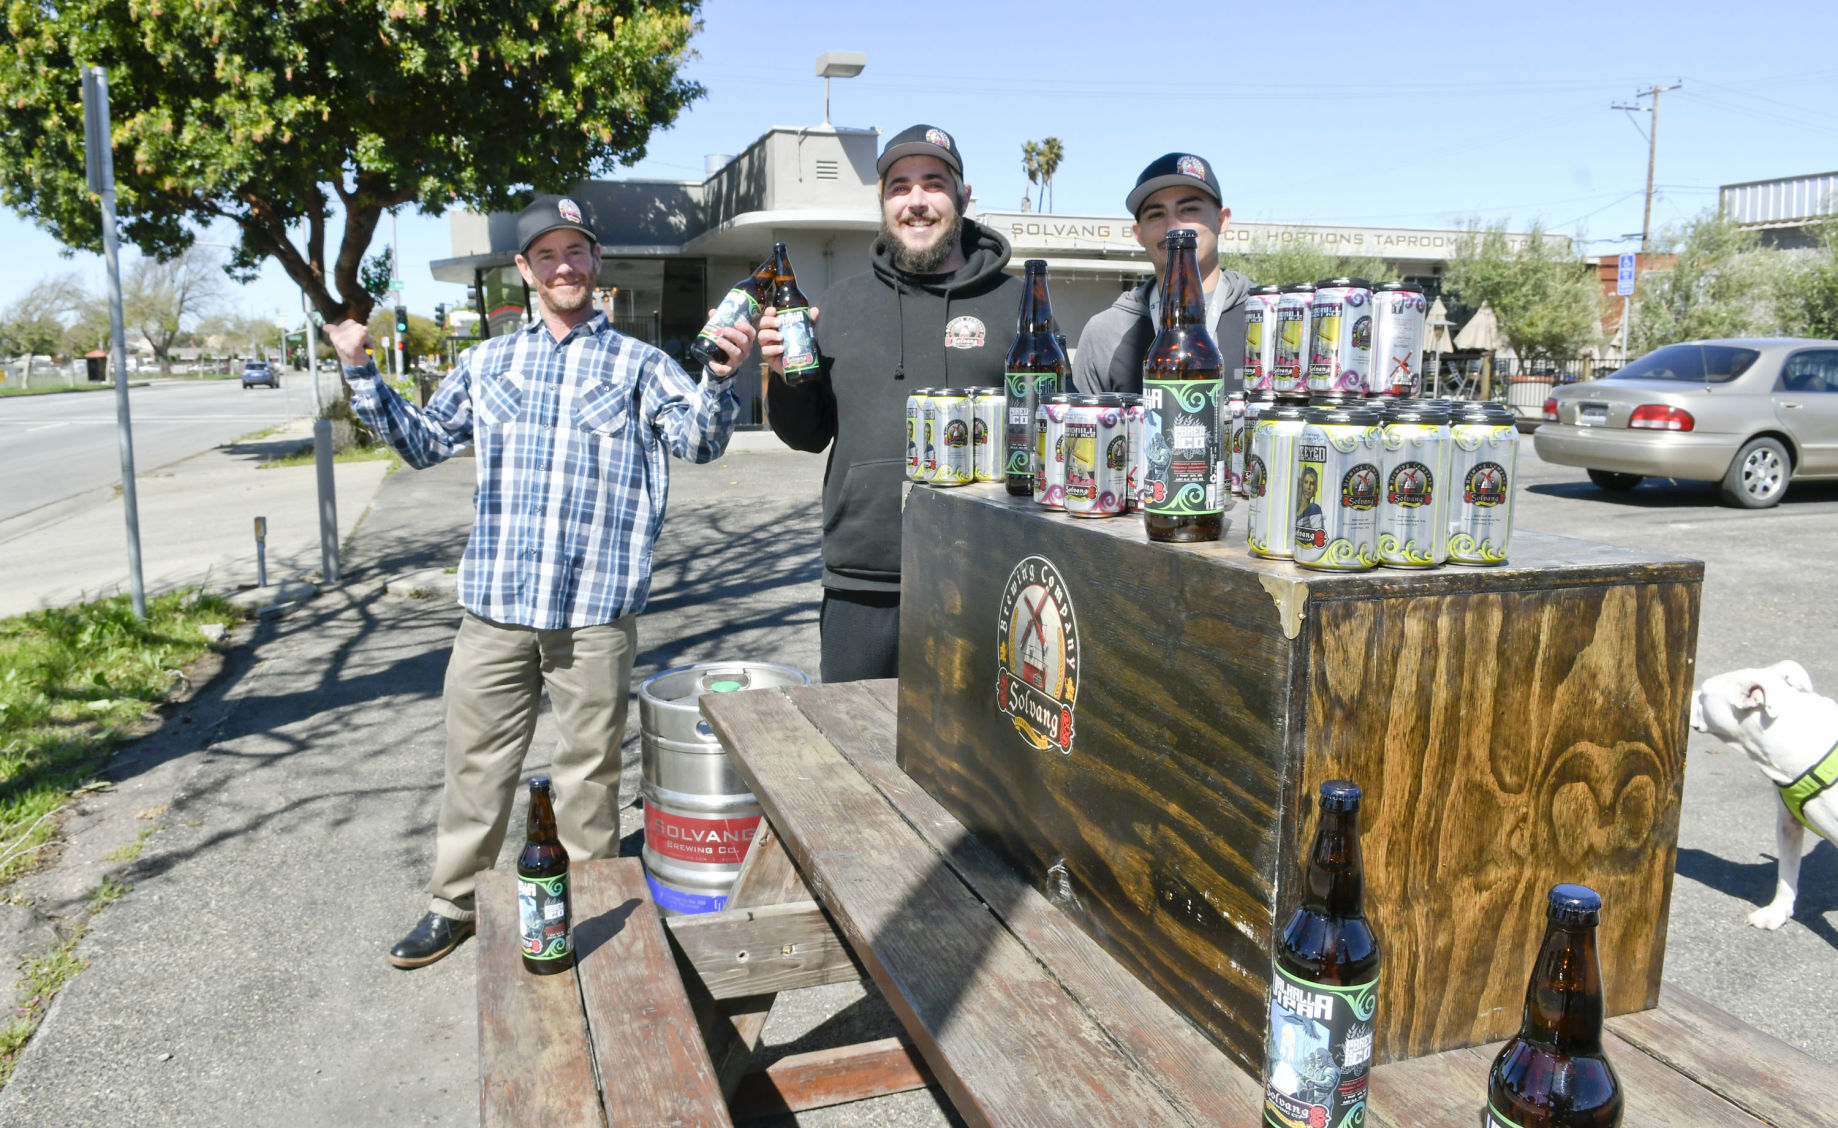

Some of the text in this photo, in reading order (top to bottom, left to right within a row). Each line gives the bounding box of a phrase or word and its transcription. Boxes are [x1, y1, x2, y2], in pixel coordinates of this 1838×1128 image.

[1011, 223, 1110, 238] SOLVANG
[1000, 563, 1076, 670] Brewing Company
[1008, 680, 1059, 738] Solvang
[655, 818, 757, 843] SOLVANG
[666, 840, 713, 854] BREWING
[1277, 990, 1314, 1019] IPA
[1266, 1082, 1309, 1119] Solvang
